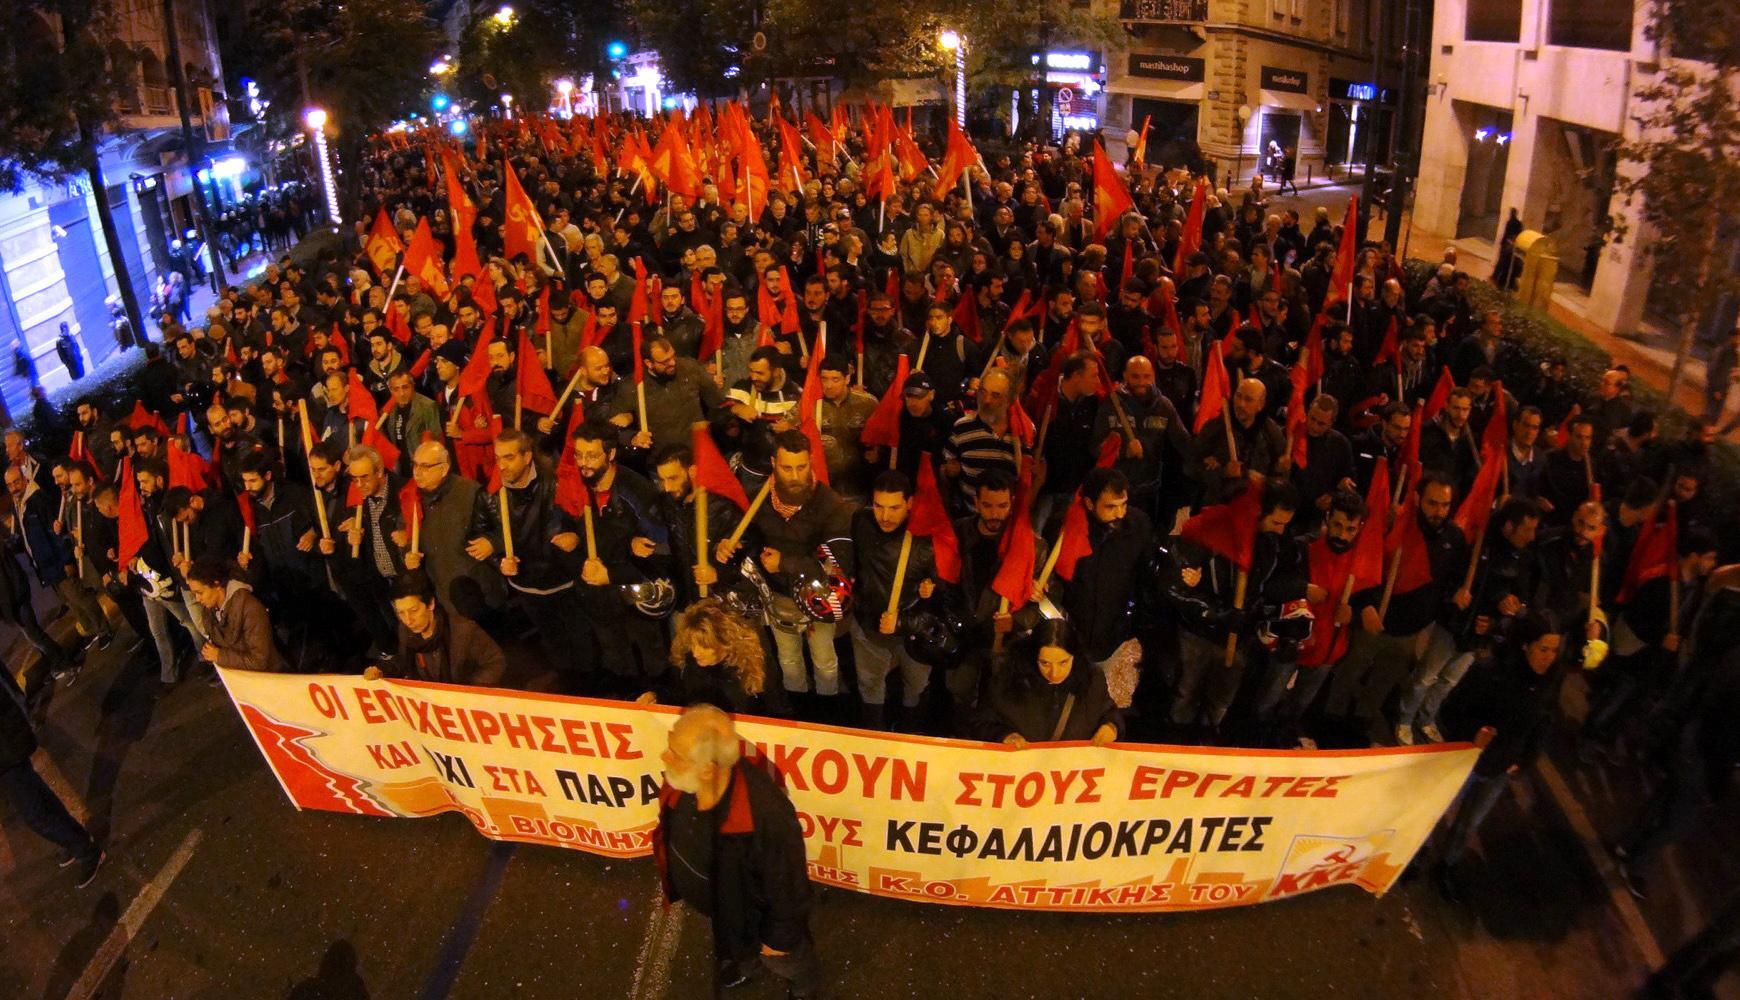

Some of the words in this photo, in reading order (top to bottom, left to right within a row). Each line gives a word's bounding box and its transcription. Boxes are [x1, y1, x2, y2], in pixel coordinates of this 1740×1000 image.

[1139, 60, 1190, 75] mastihashop
[308, 682, 350, 721] ΟΙ
[353, 687, 644, 760] ΕΠΙΧΕΙΡΗΣΕΙΣ
[738, 739, 928, 803] ΗΚΟΥΝ
[954, 767, 1106, 809] ΣΤΟΥΣ
[1128, 764, 1351, 801] ΕΡΓΑΤΕΣ
[366, 740, 422, 770] ΚΑΙ
[482, 764, 548, 798] ΣΤΑ
[555, 769, 665, 808] ΠΑΡΑ
[794, 811, 864, 848] ΟΥΣ
[886, 816, 1274, 863] ΚΕΦΑΛΑΙΟΚΡΑΤΕΣ
[511, 815, 655, 849] ΒΙΟΜΗΧ
[881, 875, 969, 899] Κ.Ο.
[988, 882, 1174, 905] ΑΤΤΙΚΗΣ
[1190, 884, 1255, 902] ΤΟΥ
